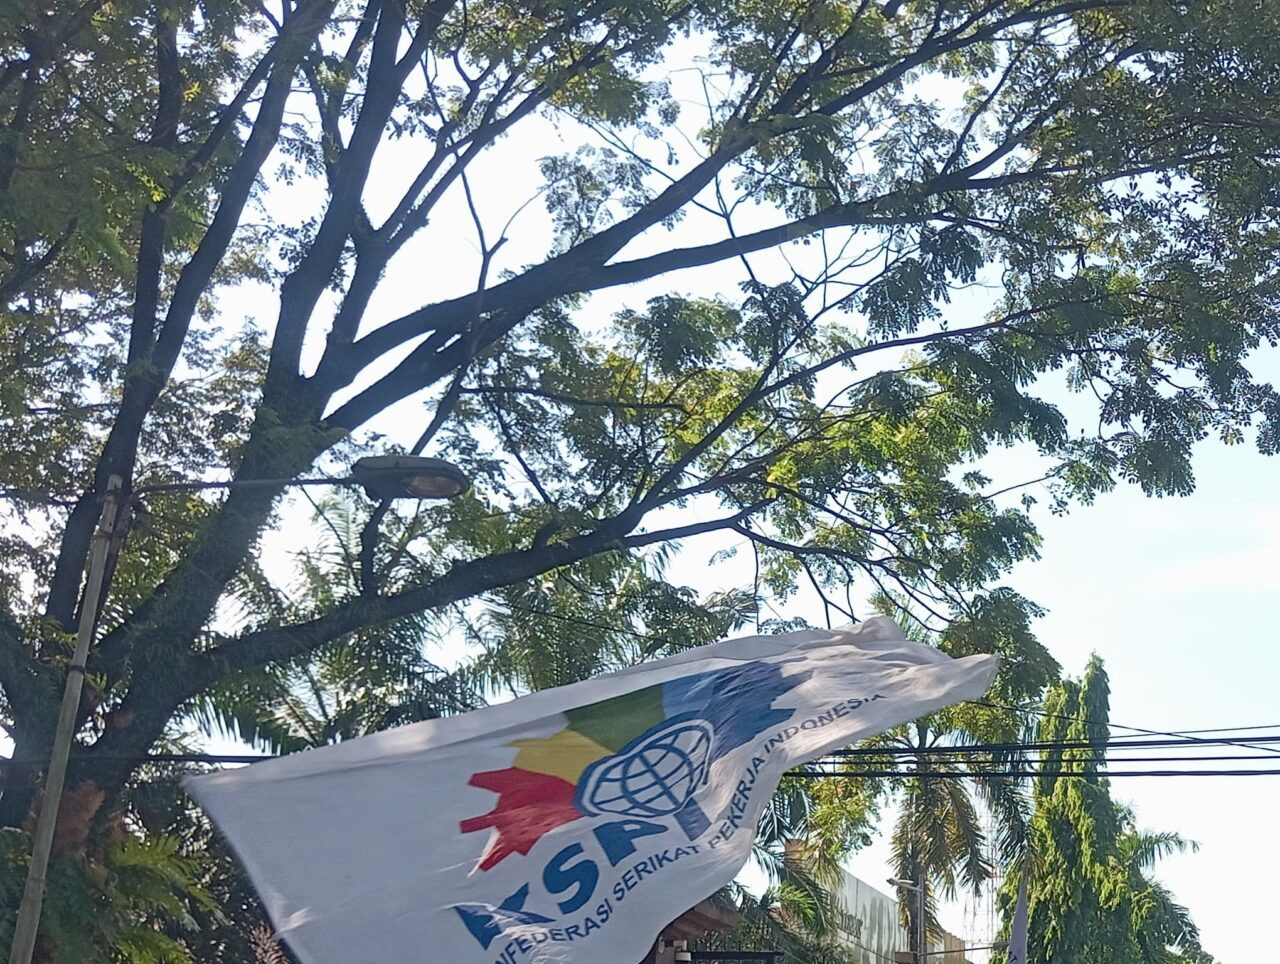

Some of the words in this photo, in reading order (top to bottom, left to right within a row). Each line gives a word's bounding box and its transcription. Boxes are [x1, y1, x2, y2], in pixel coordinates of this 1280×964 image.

[613, 845, 701, 902] SERIKAT
[707, 757, 765, 850] PEKERJA
[764, 694, 887, 755] INDONESIA
